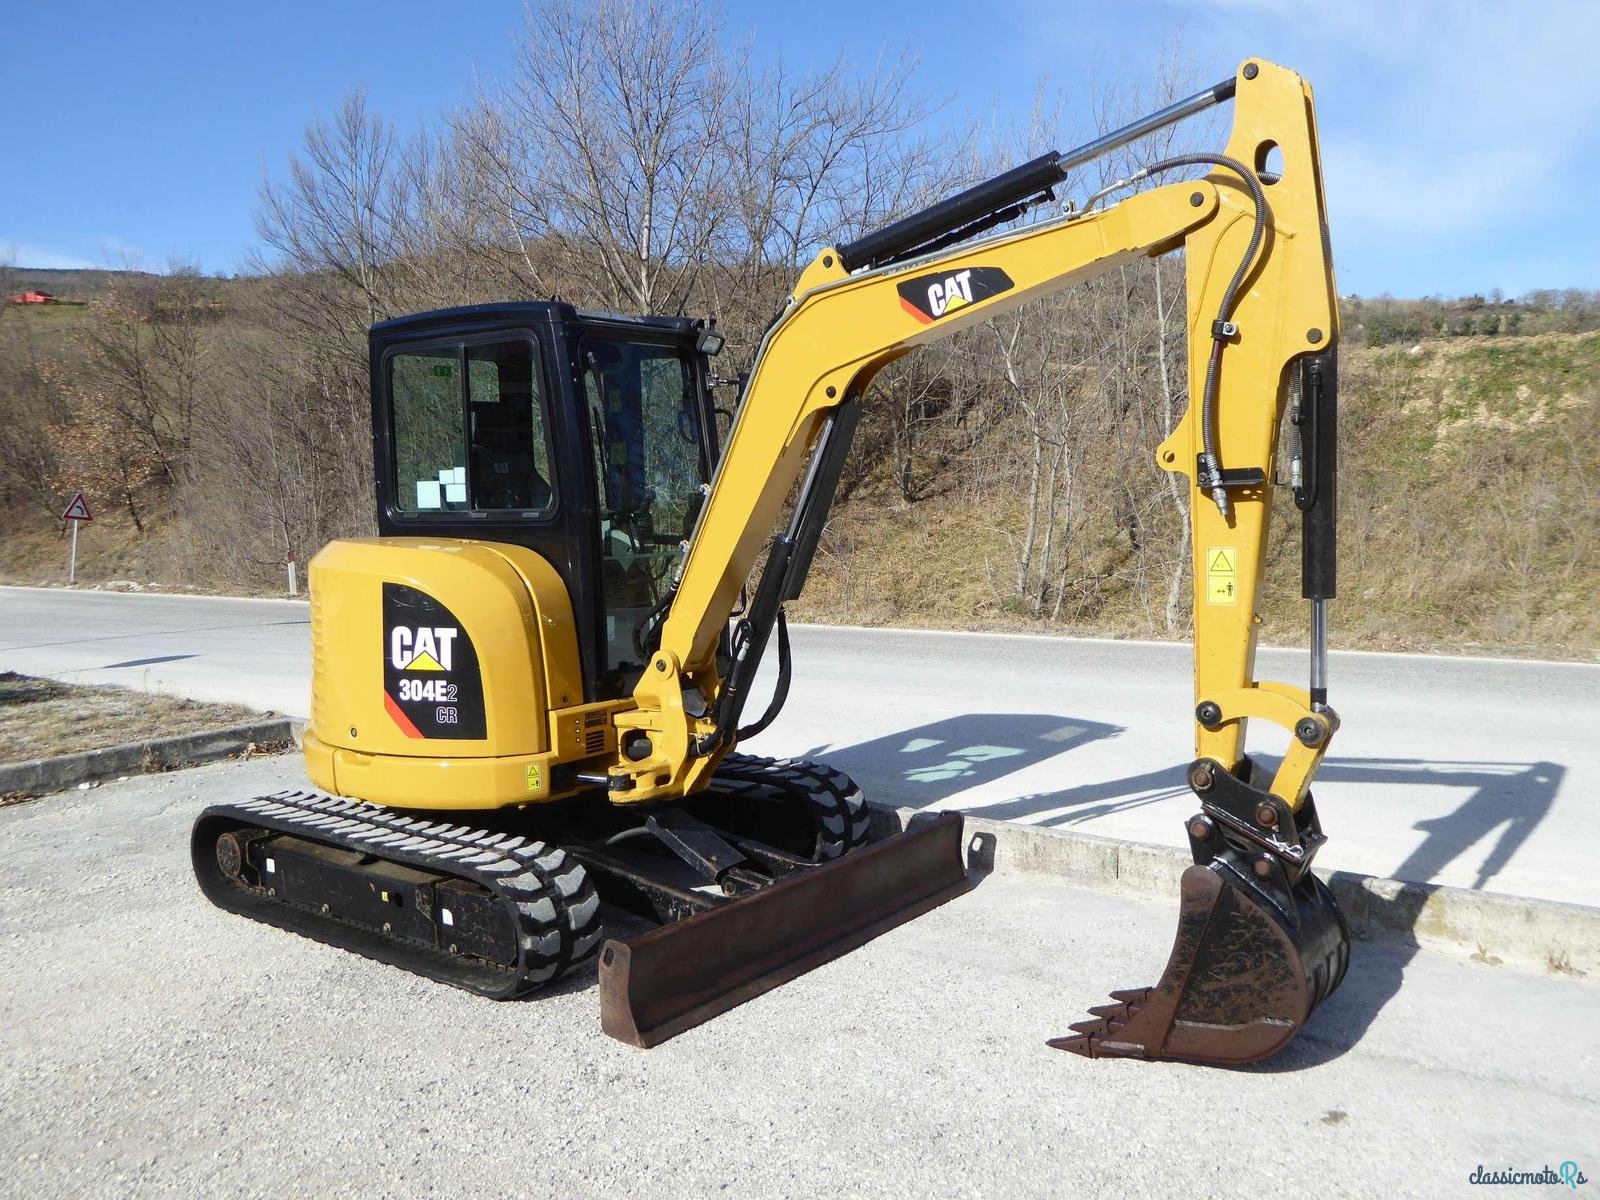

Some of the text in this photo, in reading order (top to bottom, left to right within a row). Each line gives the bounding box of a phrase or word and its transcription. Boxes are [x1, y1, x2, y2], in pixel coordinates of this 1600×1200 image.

[927, 269, 973, 317] CAT
[391, 625, 458, 671] CAT
[398, 678, 458, 702] 304E2
[436, 706, 458, 724] CR
